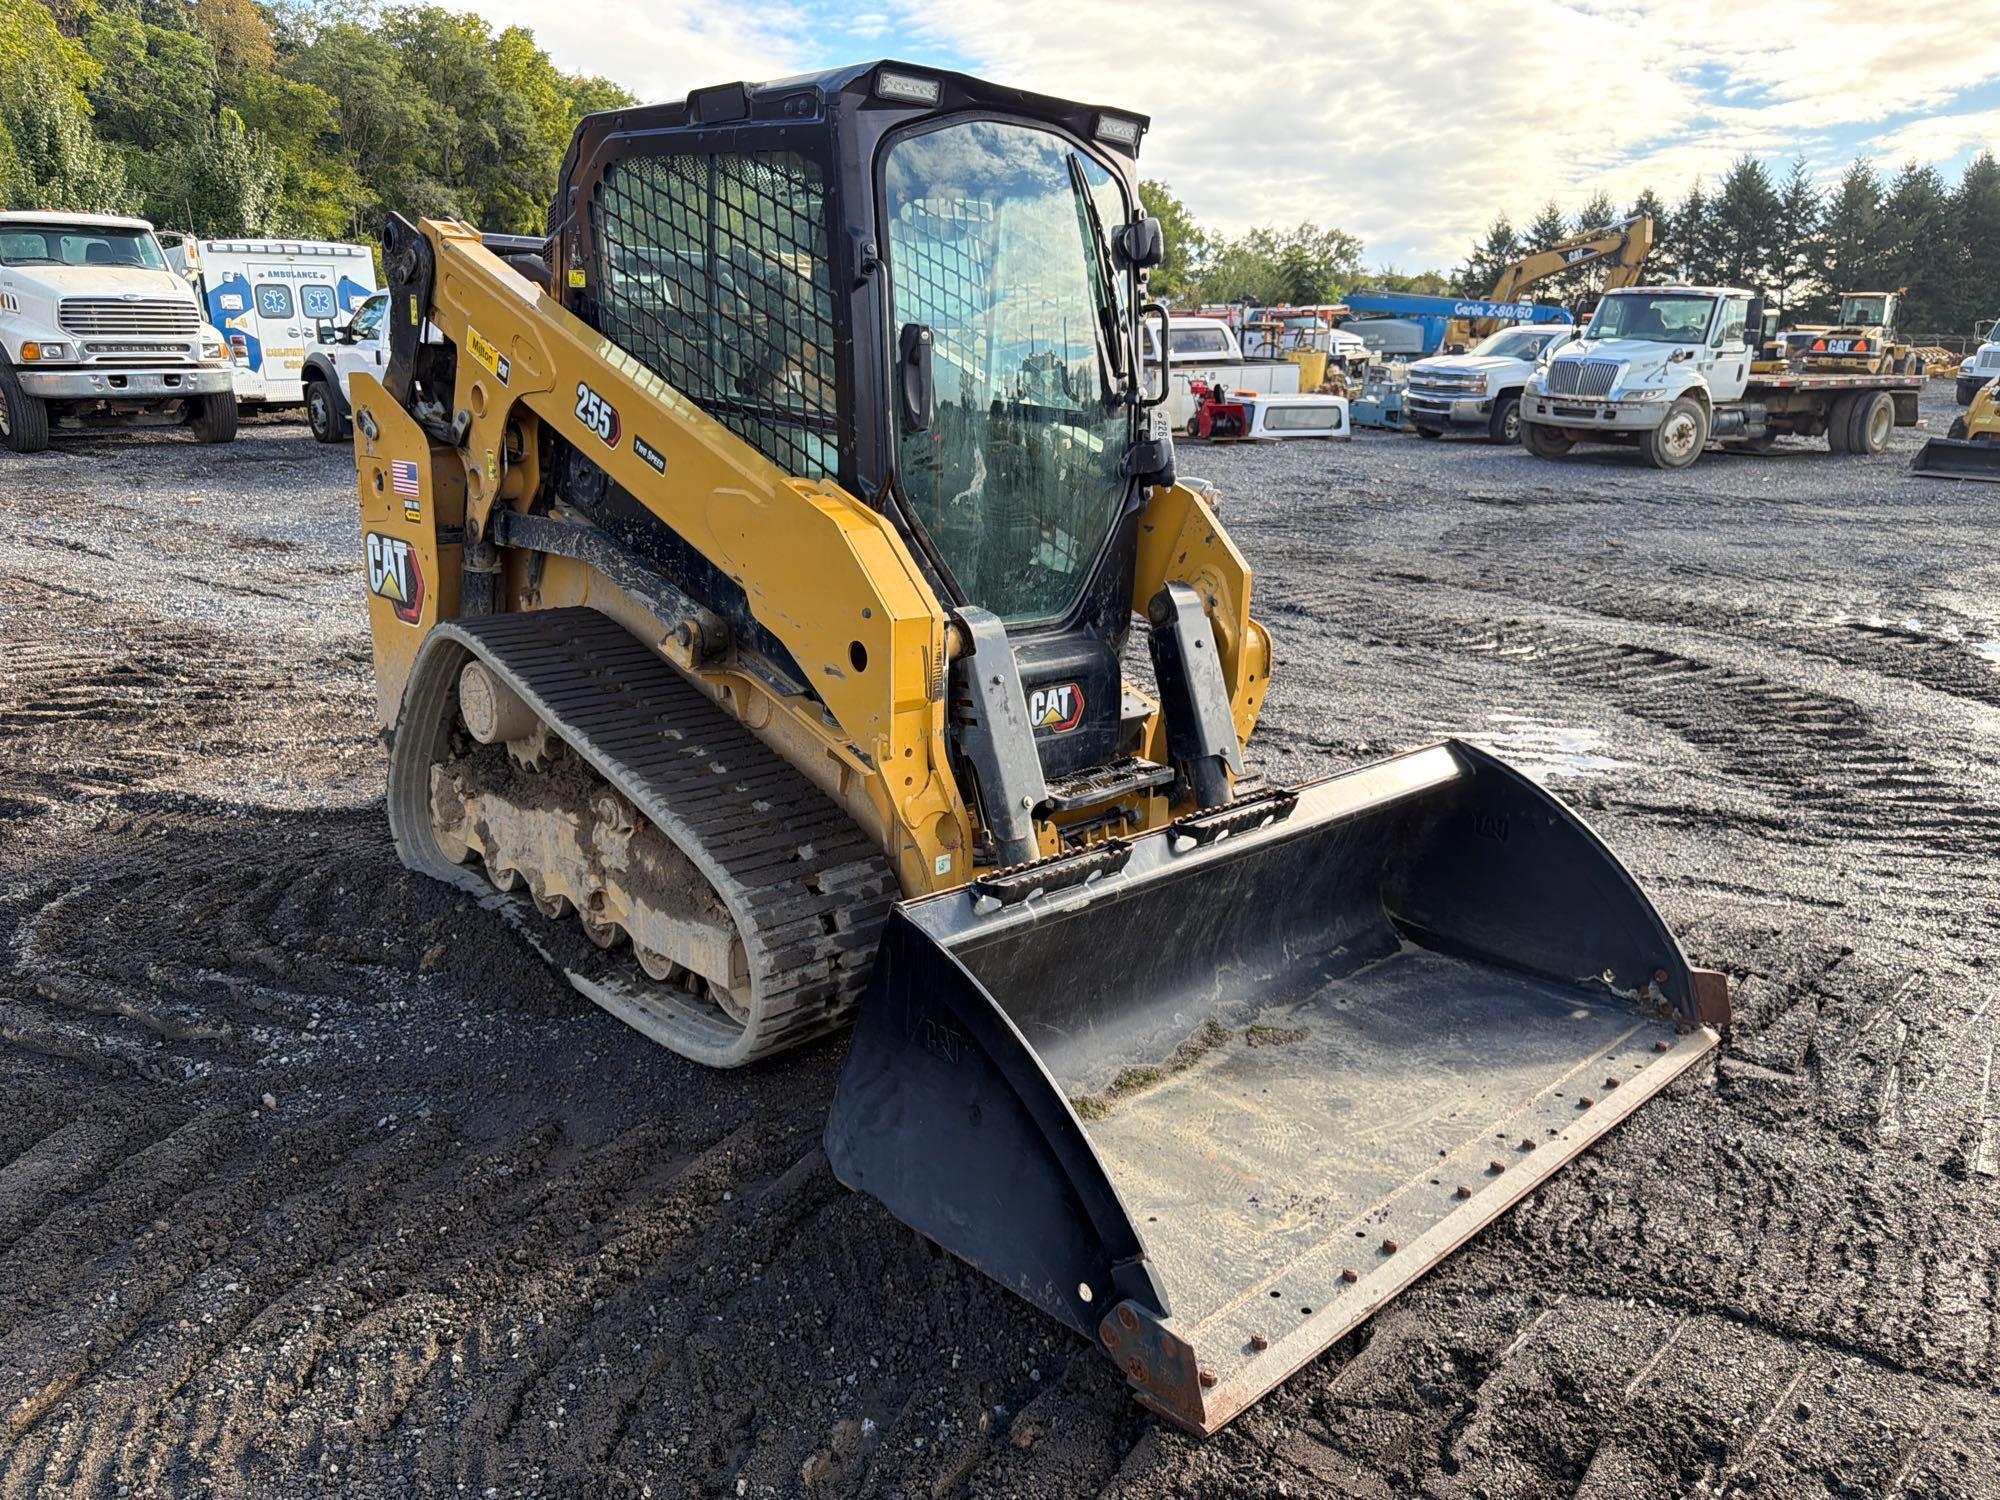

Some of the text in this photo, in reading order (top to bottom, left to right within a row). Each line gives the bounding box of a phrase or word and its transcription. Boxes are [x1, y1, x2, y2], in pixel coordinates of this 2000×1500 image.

[1568, 249, 1583, 262] CAT
[267, 270, 319, 279] AMBULANCE
[1454, 302, 1534, 319] Genie Z-80/60
[472, 337, 509, 379] Milton CAT
[1828, 339, 1852, 353] CAT
[575, 383, 612, 439] 255
[366, 532, 408, 603] CAT
[1030, 686, 1072, 727] CAT
